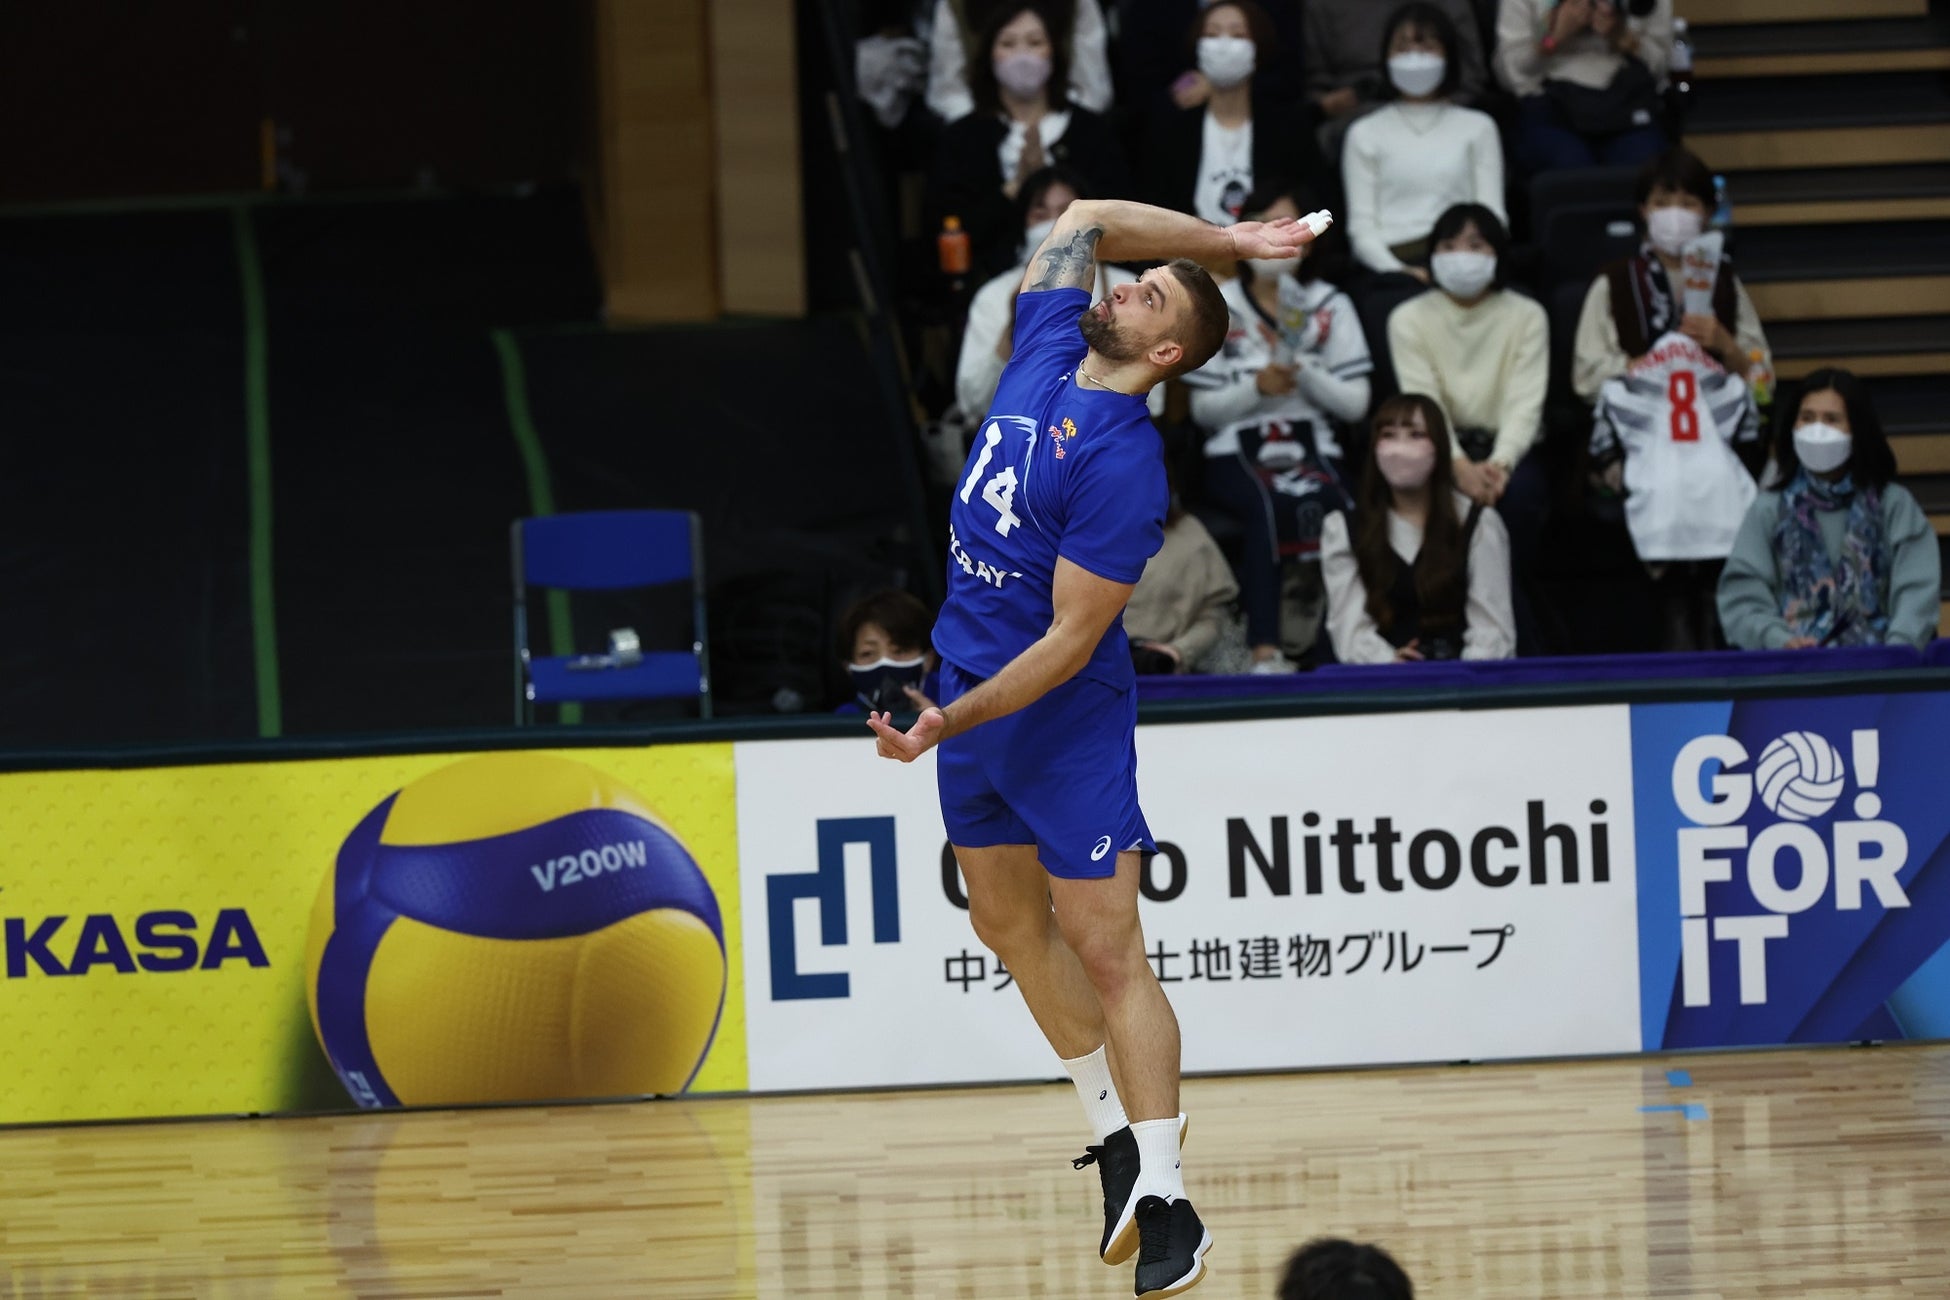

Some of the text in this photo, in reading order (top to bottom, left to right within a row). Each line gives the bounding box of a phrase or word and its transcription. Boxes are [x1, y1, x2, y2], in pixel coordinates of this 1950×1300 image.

[1669, 369, 1699, 441] 8
[960, 421, 1021, 538] 14
[530, 841, 647, 892] V200W
[1227, 800, 1610, 898] Nittochi
[1677, 820, 1911, 917] FOR
[5, 908, 270, 979] KASA
[1681, 914, 1788, 1008] IT
